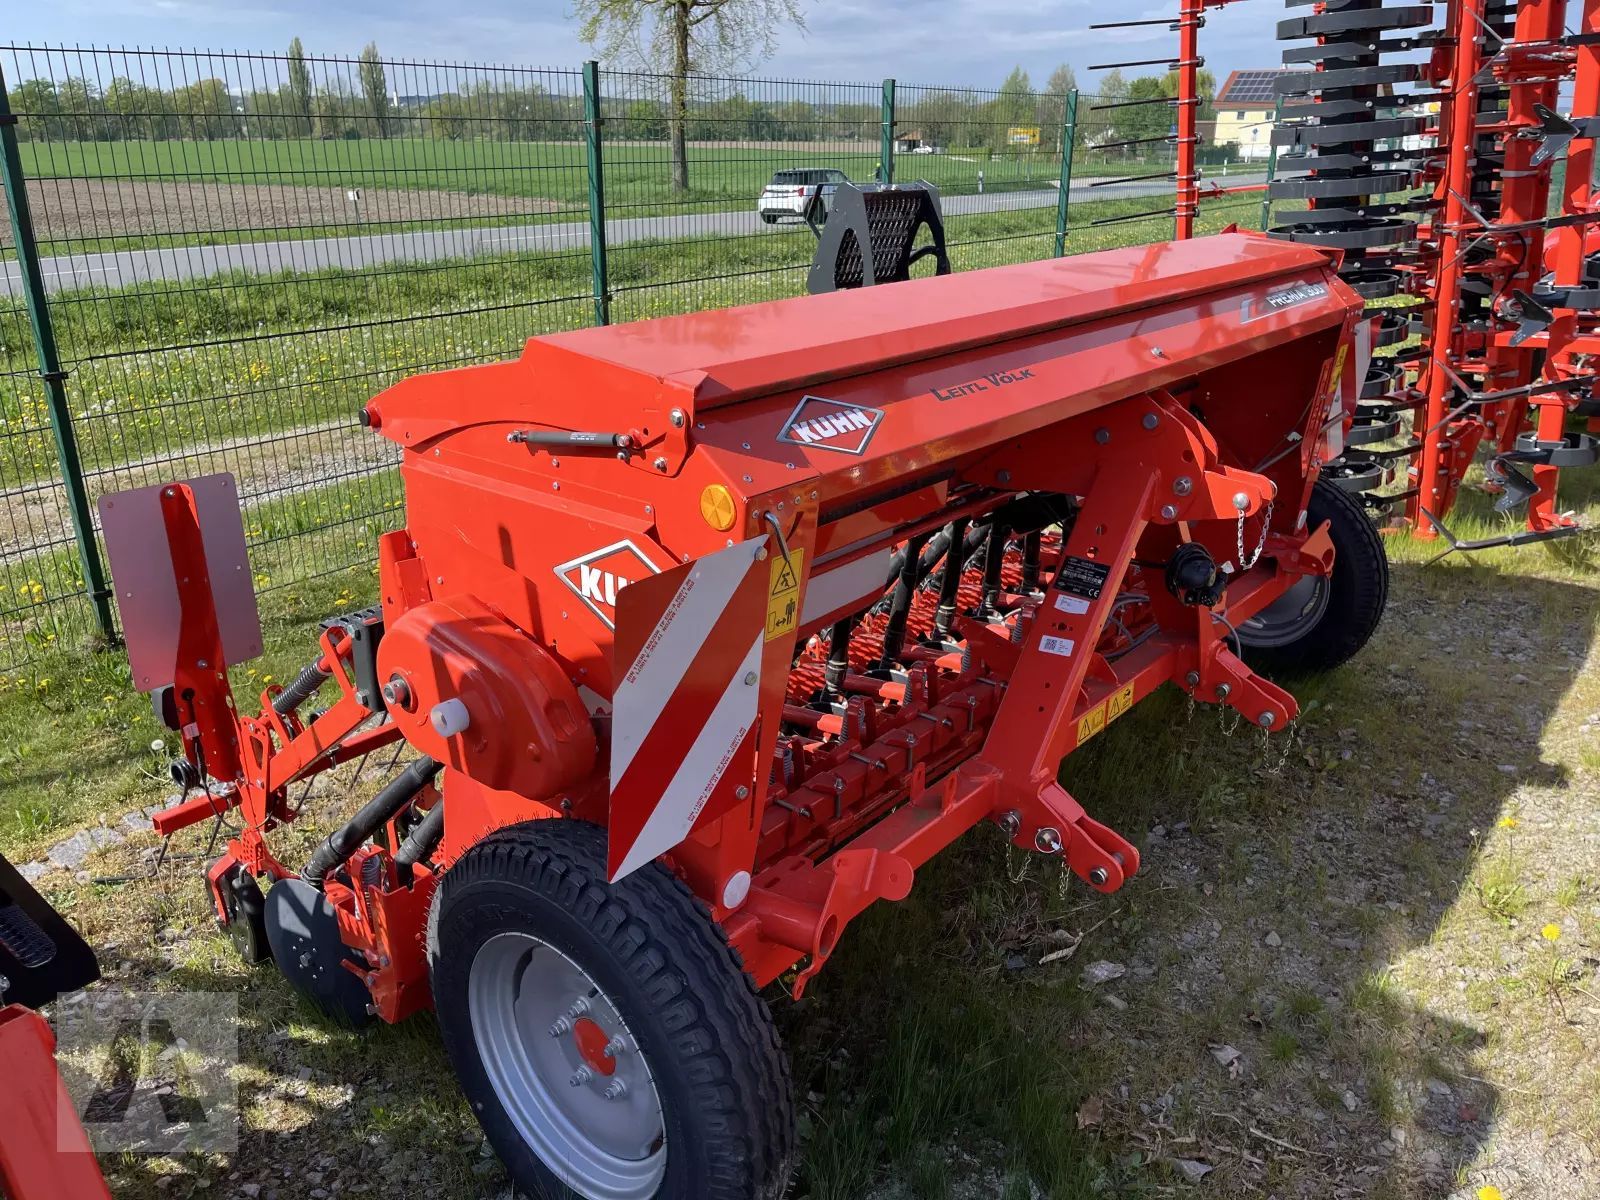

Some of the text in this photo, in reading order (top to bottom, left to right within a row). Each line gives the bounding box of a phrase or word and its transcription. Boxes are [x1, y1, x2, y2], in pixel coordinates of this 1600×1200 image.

[1266, 288, 1307, 308] PREMIA
[929, 368, 1036, 402] LEITL VÖLK
[792, 408, 874, 443] KUHN
[580, 563, 636, 607] KU
